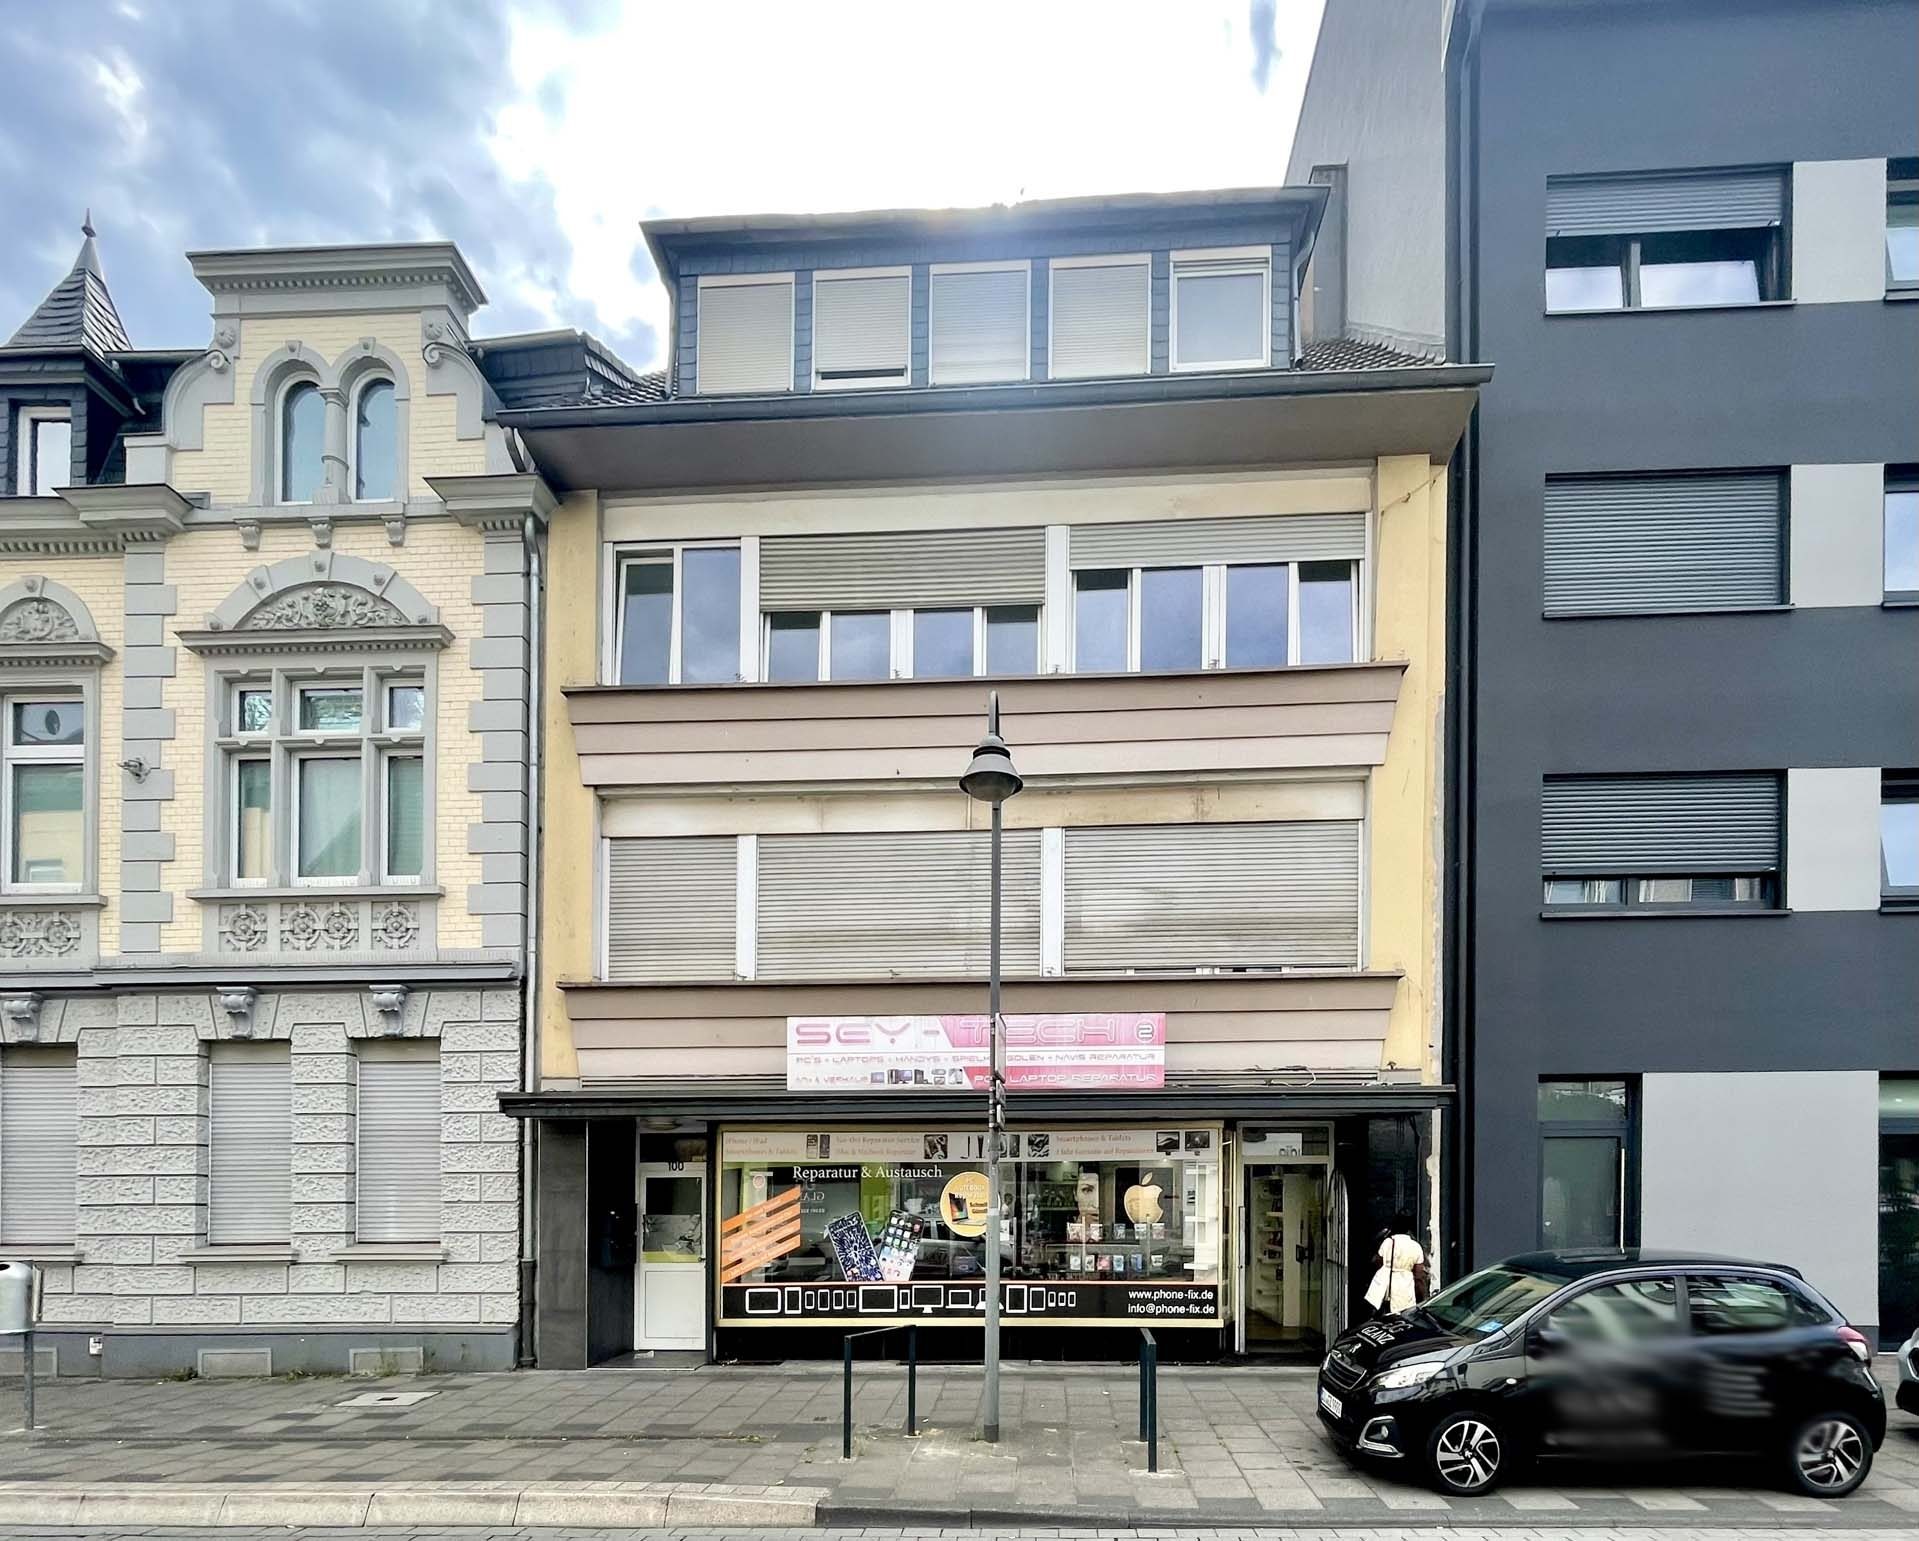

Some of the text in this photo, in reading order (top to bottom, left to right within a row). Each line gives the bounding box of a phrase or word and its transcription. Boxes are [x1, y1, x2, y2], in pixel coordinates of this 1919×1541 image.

[1009, 1074, 1066, 1083] LAPTOP
[668, 1161, 685, 1171] 100
[793, 1164, 943, 1181] Reparatur & Austausch
[1128, 1289, 1214, 1301] www.phone-fix.de
[1128, 1303, 1216, 1316] info@phone-fix.de
[1361, 1326, 1395, 1345] GLANZ
